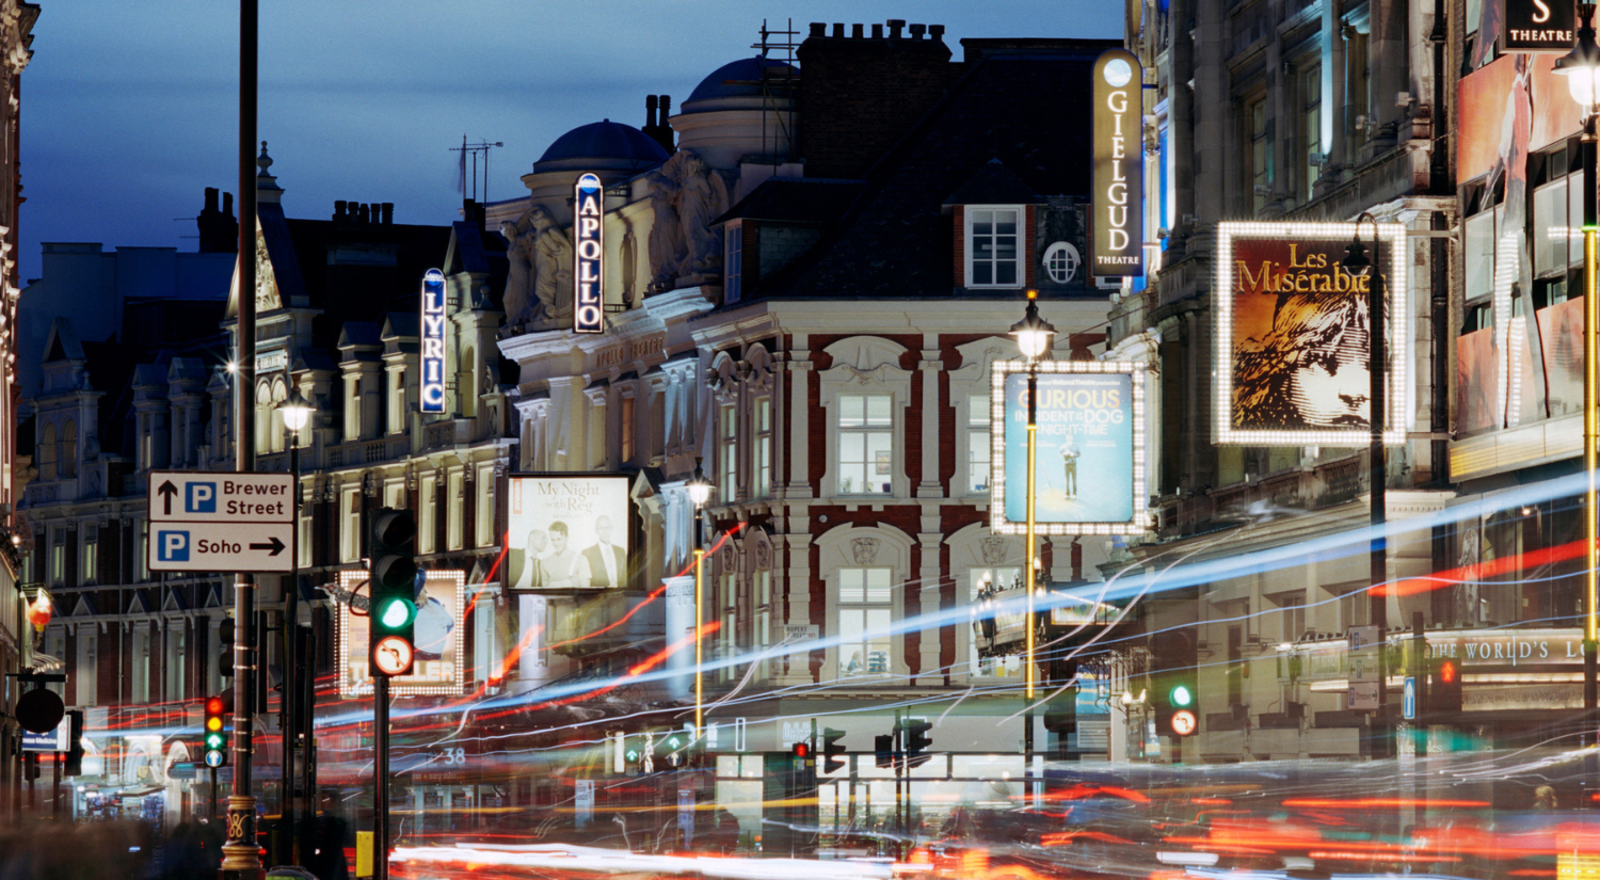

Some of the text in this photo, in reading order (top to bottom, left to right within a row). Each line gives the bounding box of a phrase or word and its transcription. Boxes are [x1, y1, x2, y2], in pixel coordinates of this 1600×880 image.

[1510, 29, 1572, 41] THEATRE
[1107, 91, 1129, 250] GIELGUD
[578, 195, 600, 325] APOLLO
[1097, 256, 1139, 264] THEATRE
[1288, 243, 1327, 268] Les
[1235, 260, 1386, 294] Misérable
[423, 292, 443, 405] LYRIC
[596, 337, 663, 368] APOLLO THEATRE
[1014, 409, 1074, 422] INIDENT
[1084, 409, 1124, 424] DOG
[192, 485, 212, 510] P
[223, 481, 287, 495] Brewer
[537, 481, 600, 501] My Night
[226, 500, 283, 514] Street
[545, 498, 593, 515] with Reg
[165, 533, 185, 559] P
[197, 539, 241, 554] Soho
[1432, 641, 1584, 659] THE WORLD'S L
[444, 748, 465, 765] 38
